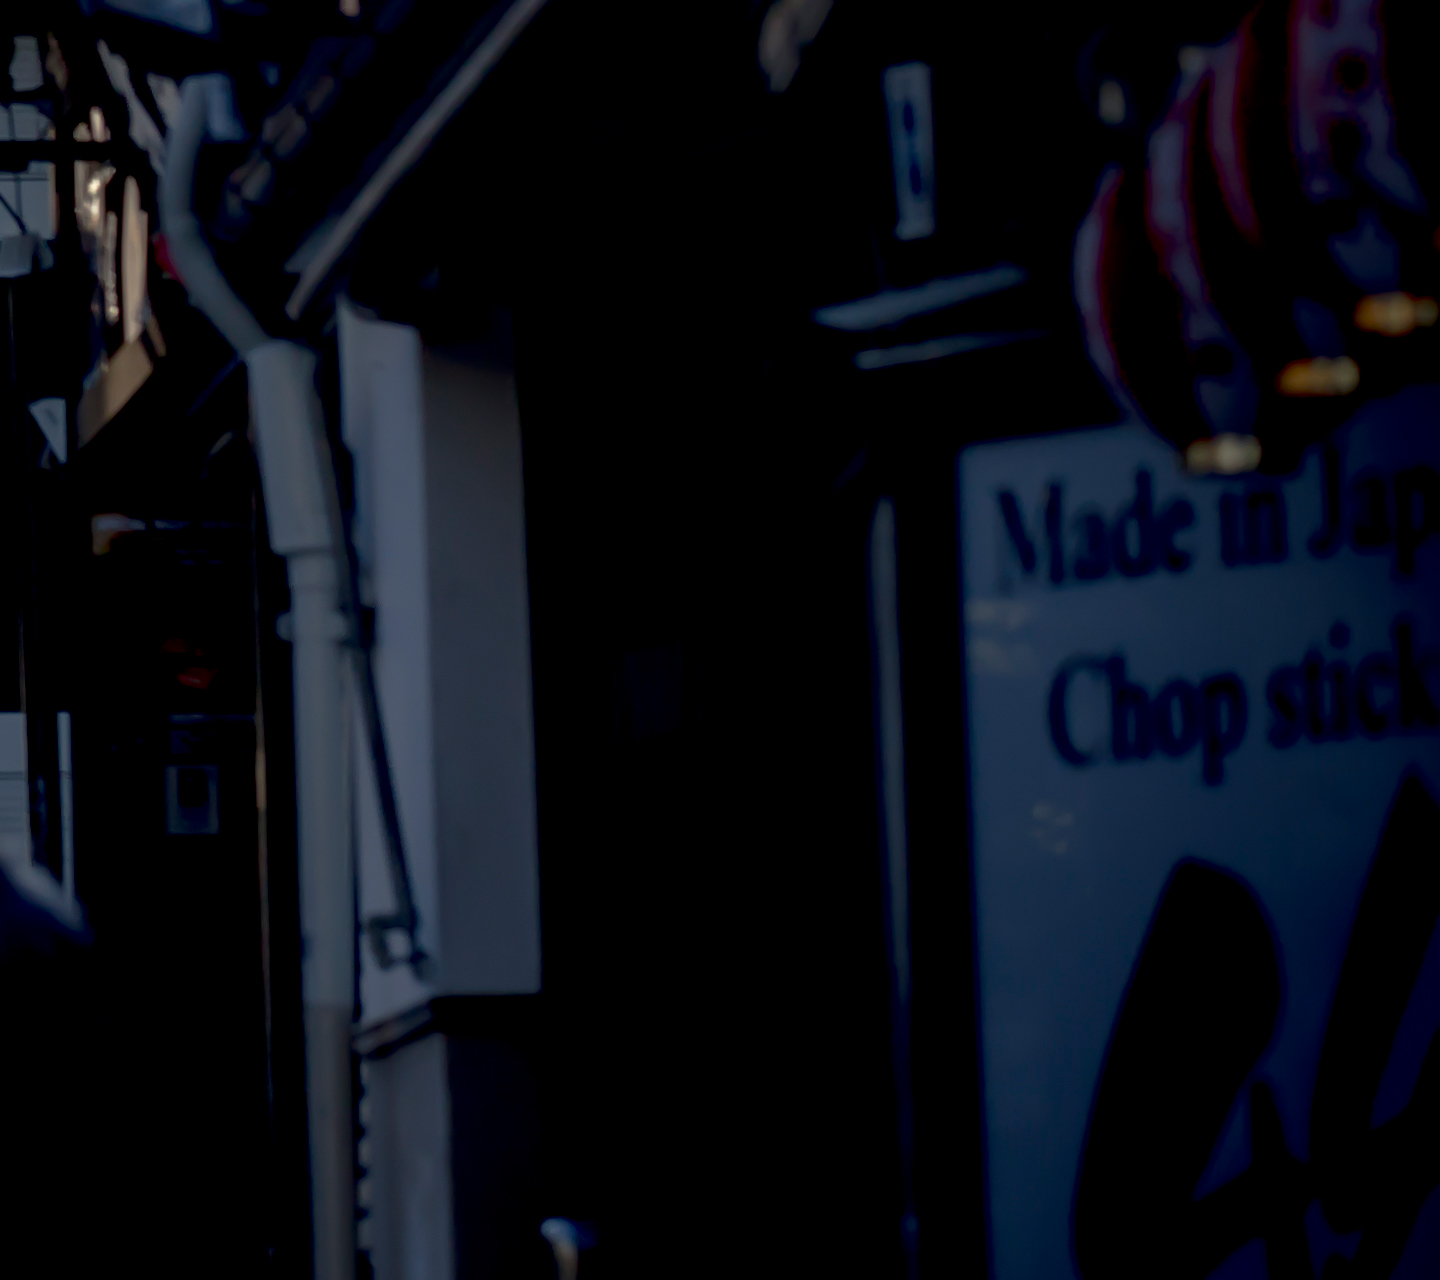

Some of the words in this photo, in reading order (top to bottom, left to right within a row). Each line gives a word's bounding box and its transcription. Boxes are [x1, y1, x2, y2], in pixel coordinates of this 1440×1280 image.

[995, 462, 1198, 588] Made
[1217, 474, 1291, 566] in
[1048, 651, 1249, 788] Chop
